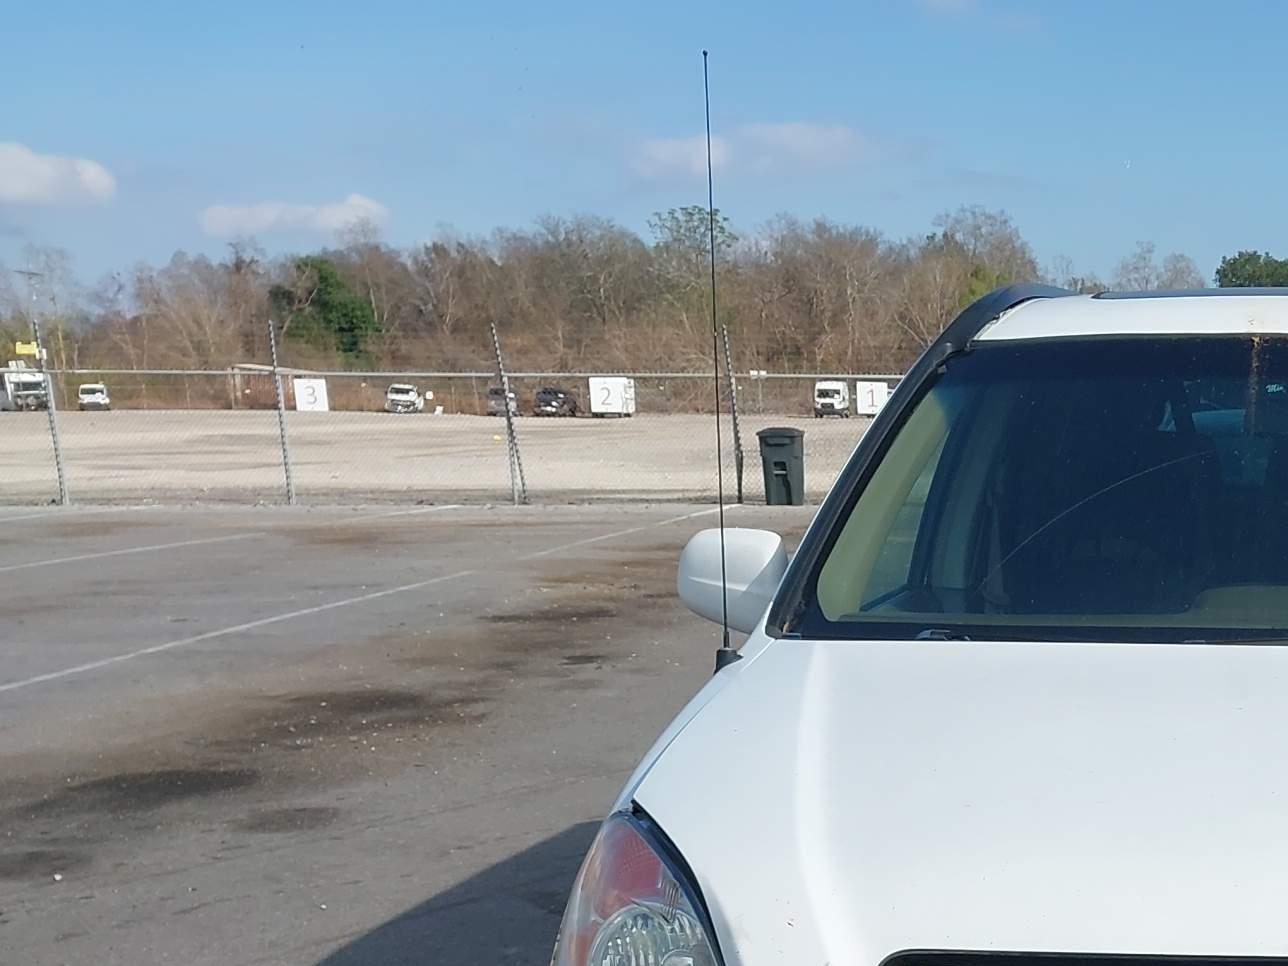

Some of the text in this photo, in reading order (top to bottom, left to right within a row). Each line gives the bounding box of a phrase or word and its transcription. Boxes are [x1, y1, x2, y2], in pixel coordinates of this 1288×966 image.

[304, 385, 318, 405] 3
[600, 386, 612, 406] 2
[867, 389, 878, 408] 1
